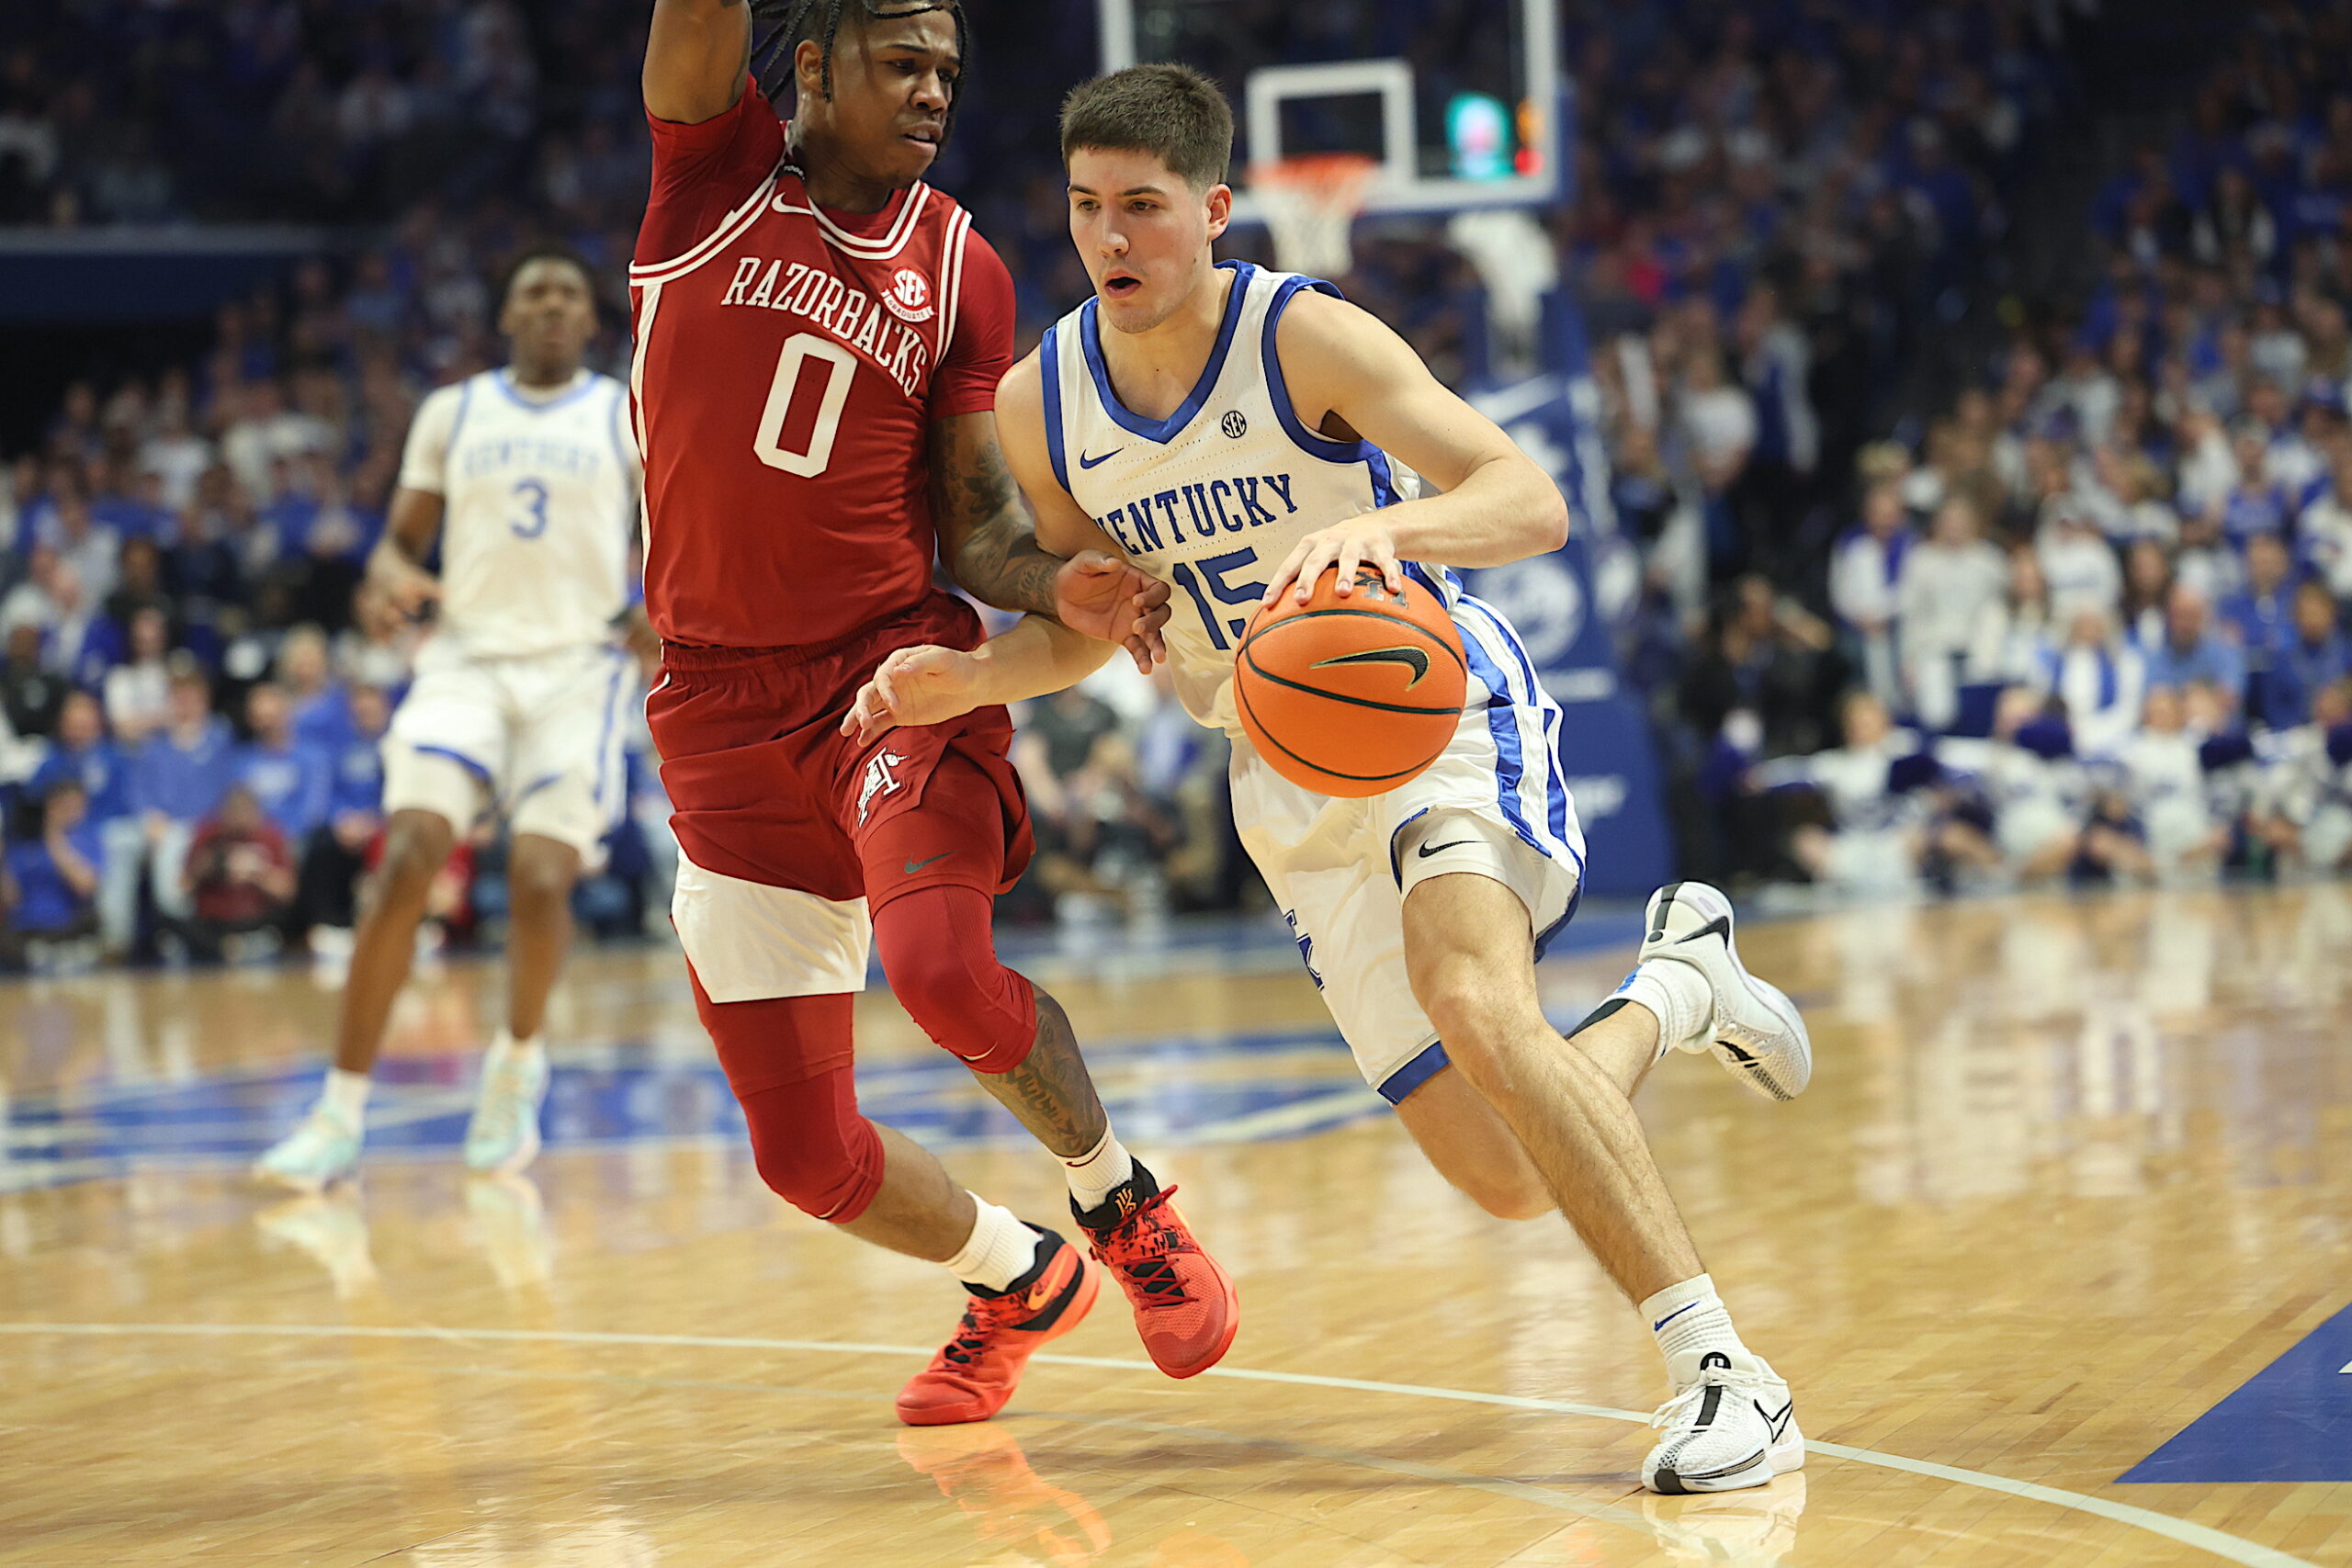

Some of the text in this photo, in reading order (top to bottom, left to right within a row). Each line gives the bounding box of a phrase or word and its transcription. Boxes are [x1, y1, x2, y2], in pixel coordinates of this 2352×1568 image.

[720, 257, 927, 397] RAZORBACKS
[893, 269, 927, 307] SEC
[752, 332, 858, 479] 0
[1222, 412, 1246, 438] SEC
[511, 477, 548, 540] 3
[1093, 473, 1298, 555] ENTUCKY
[1172, 547, 1270, 650] 15
